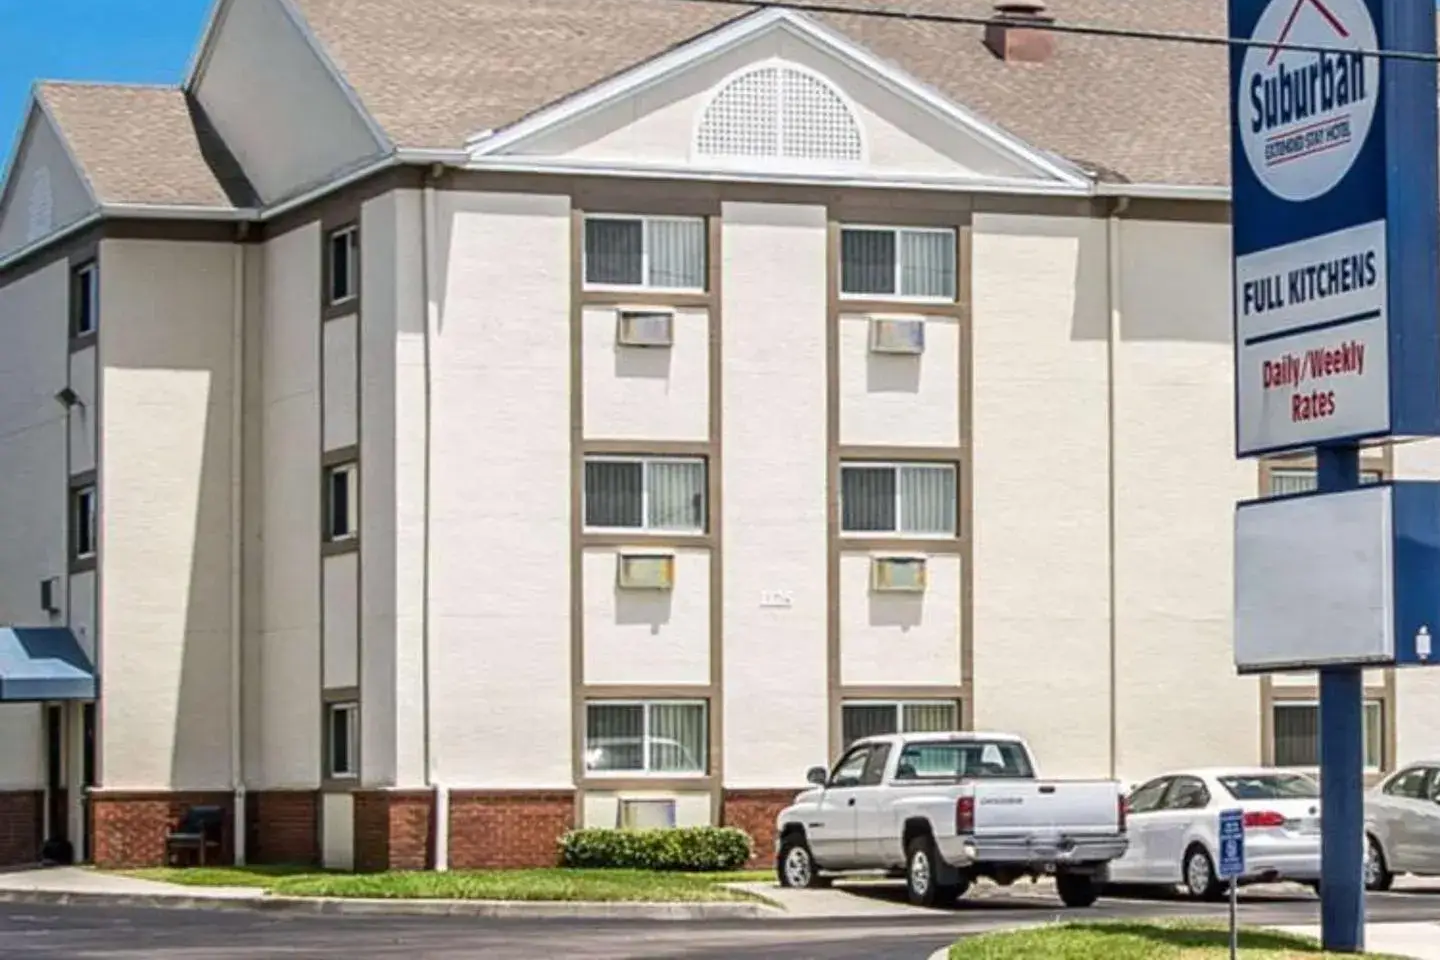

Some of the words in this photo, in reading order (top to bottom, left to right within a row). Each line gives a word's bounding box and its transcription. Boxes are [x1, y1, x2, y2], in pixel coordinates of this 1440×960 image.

[1251, 51, 1365, 133] Suburban
[1244, 277, 1284, 315] FULL
[1288, 251, 1376, 306] KITCHENS
[1262, 341, 1365, 389] Daily/Weekly
[1291, 391, 1336, 422] Rates
